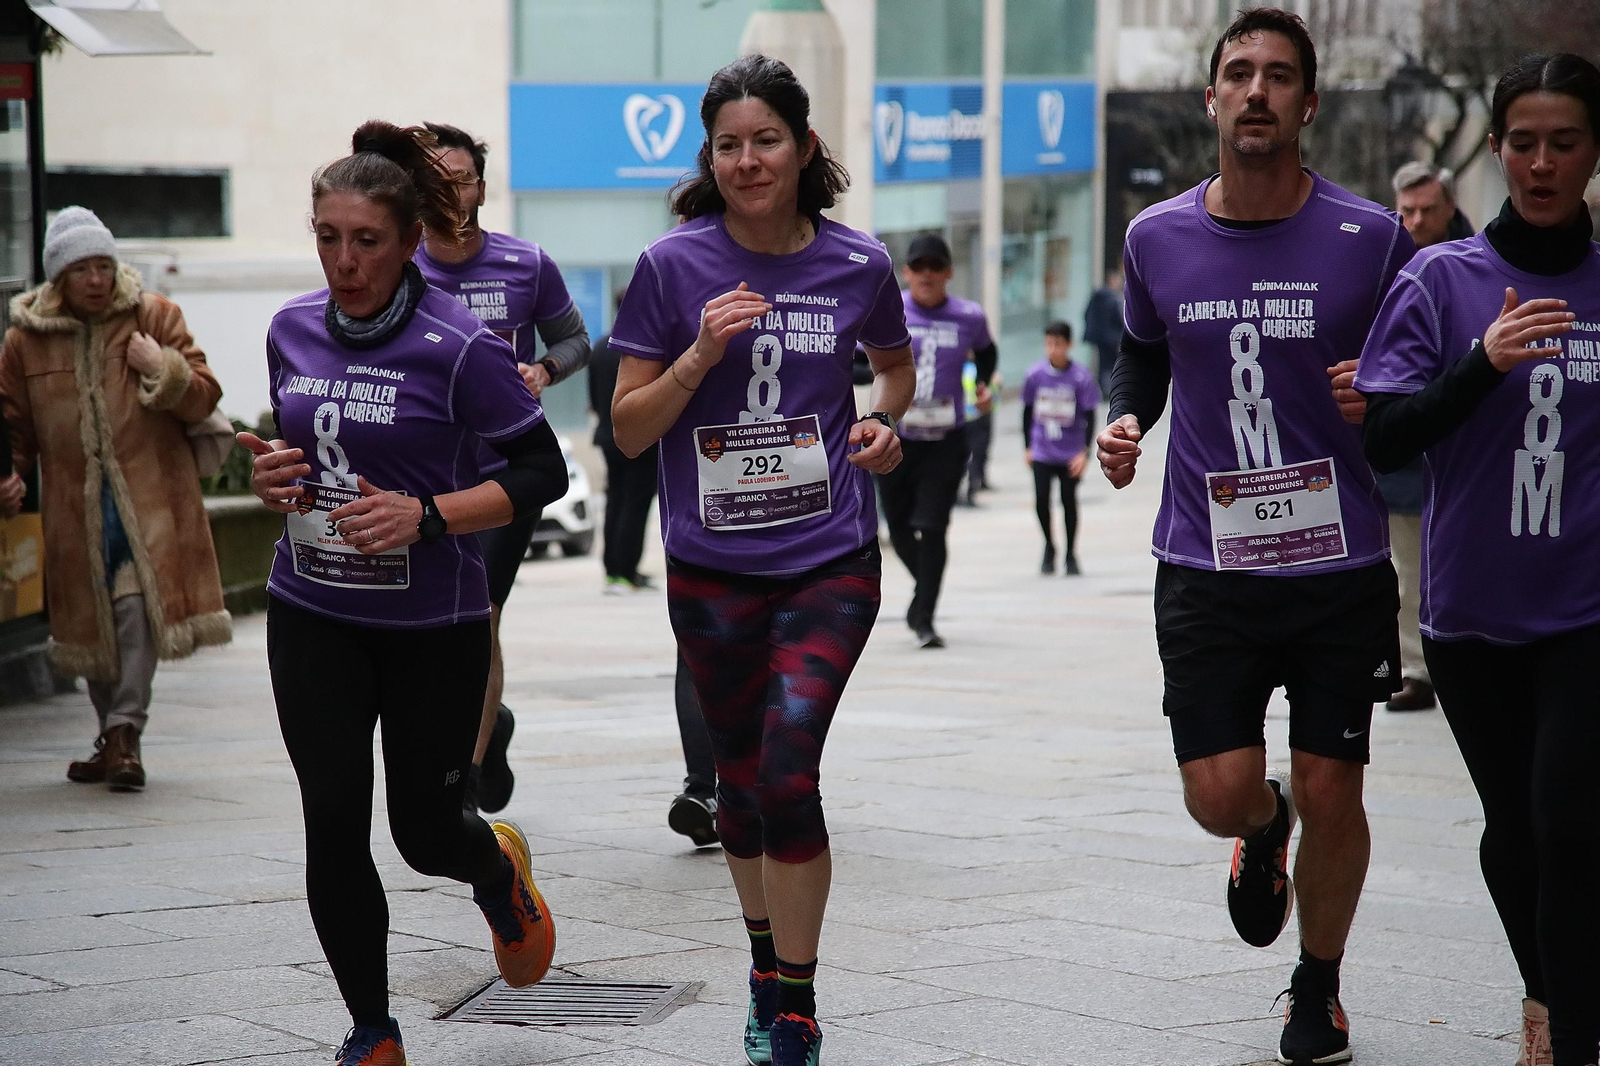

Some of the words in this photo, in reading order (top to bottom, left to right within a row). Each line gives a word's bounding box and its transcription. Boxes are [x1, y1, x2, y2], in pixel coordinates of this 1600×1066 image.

[470, 292, 506, 306] MULLER
[1178, 299, 1238, 323] CARREIRA
[1242, 299, 1261, 319] DA
[1264, 299, 1314, 318] MULLER
[765, 310, 784, 331] DA
[787, 311, 834, 333] MULLER
[1261, 319, 1316, 340] OURENSE
[785, 332, 837, 355] OURENSE
[286, 375, 330, 398] CARREIRA
[331, 381, 347, 399] DA
[350, 382, 397, 404] MULLER
[343, 401, 396, 425] OURENSE
[726, 429, 737, 437] VII
[738, 426, 775, 436] CARREIRA
[776, 425, 788, 433] DA
[725, 439, 755, 448] MULLER
[756, 435, 791, 445] OURENSE
[741, 454, 784, 477] 292
[754, 476, 776, 484] LODEIRO
[1250, 472, 1288, 483] CARREIRA
[1289, 470, 1300, 478] DA
[801, 486, 825, 496] OURENSE
[1237, 485, 1267, 494] MULLER
[1268, 479, 1304, 491] OURENSE
[318, 489, 326, 497] VII
[326, 490, 359, 500] CARREIRA
[315, 499, 340, 509] MULLER
[1255, 498, 1294, 521] 621
[1313, 529, 1338, 538] OURENSE
